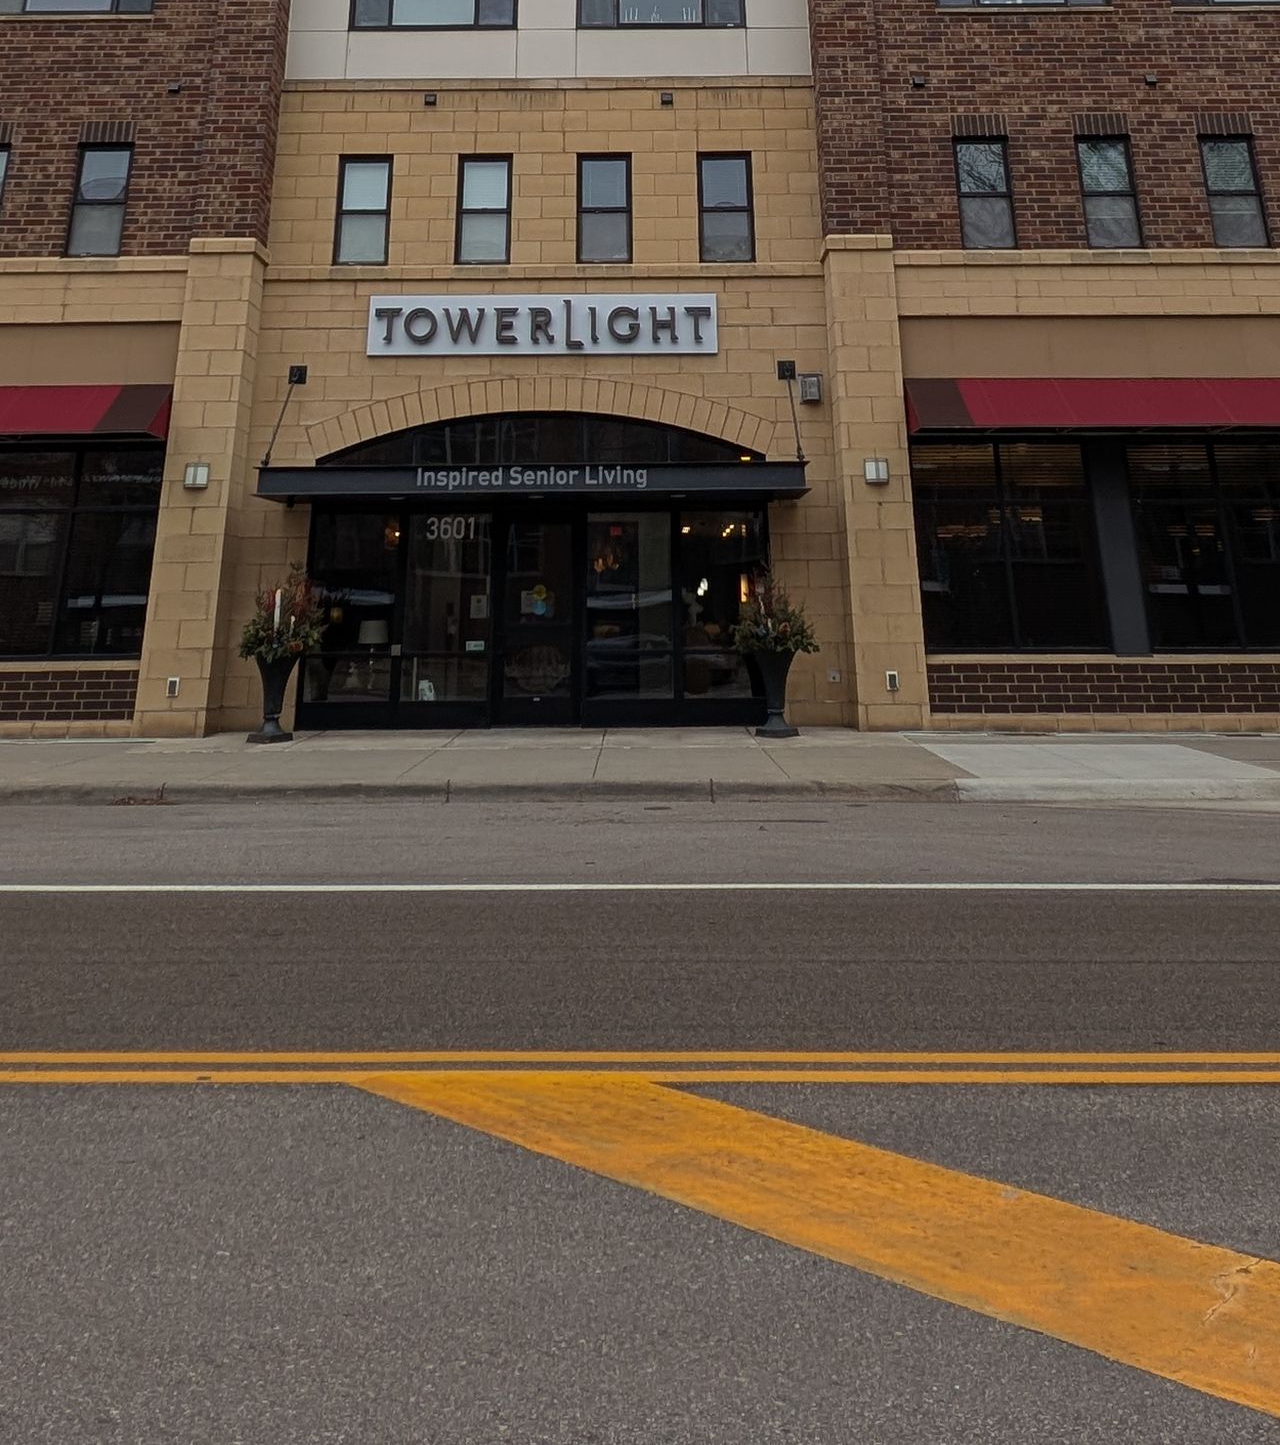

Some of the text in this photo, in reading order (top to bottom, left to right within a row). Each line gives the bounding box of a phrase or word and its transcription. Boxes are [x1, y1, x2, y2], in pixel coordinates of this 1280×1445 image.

[374, 299, 713, 349] TOWERLIGHT
[416, 465, 648, 490] Inspired Senior Living
[426, 516, 475, 540] 3601
